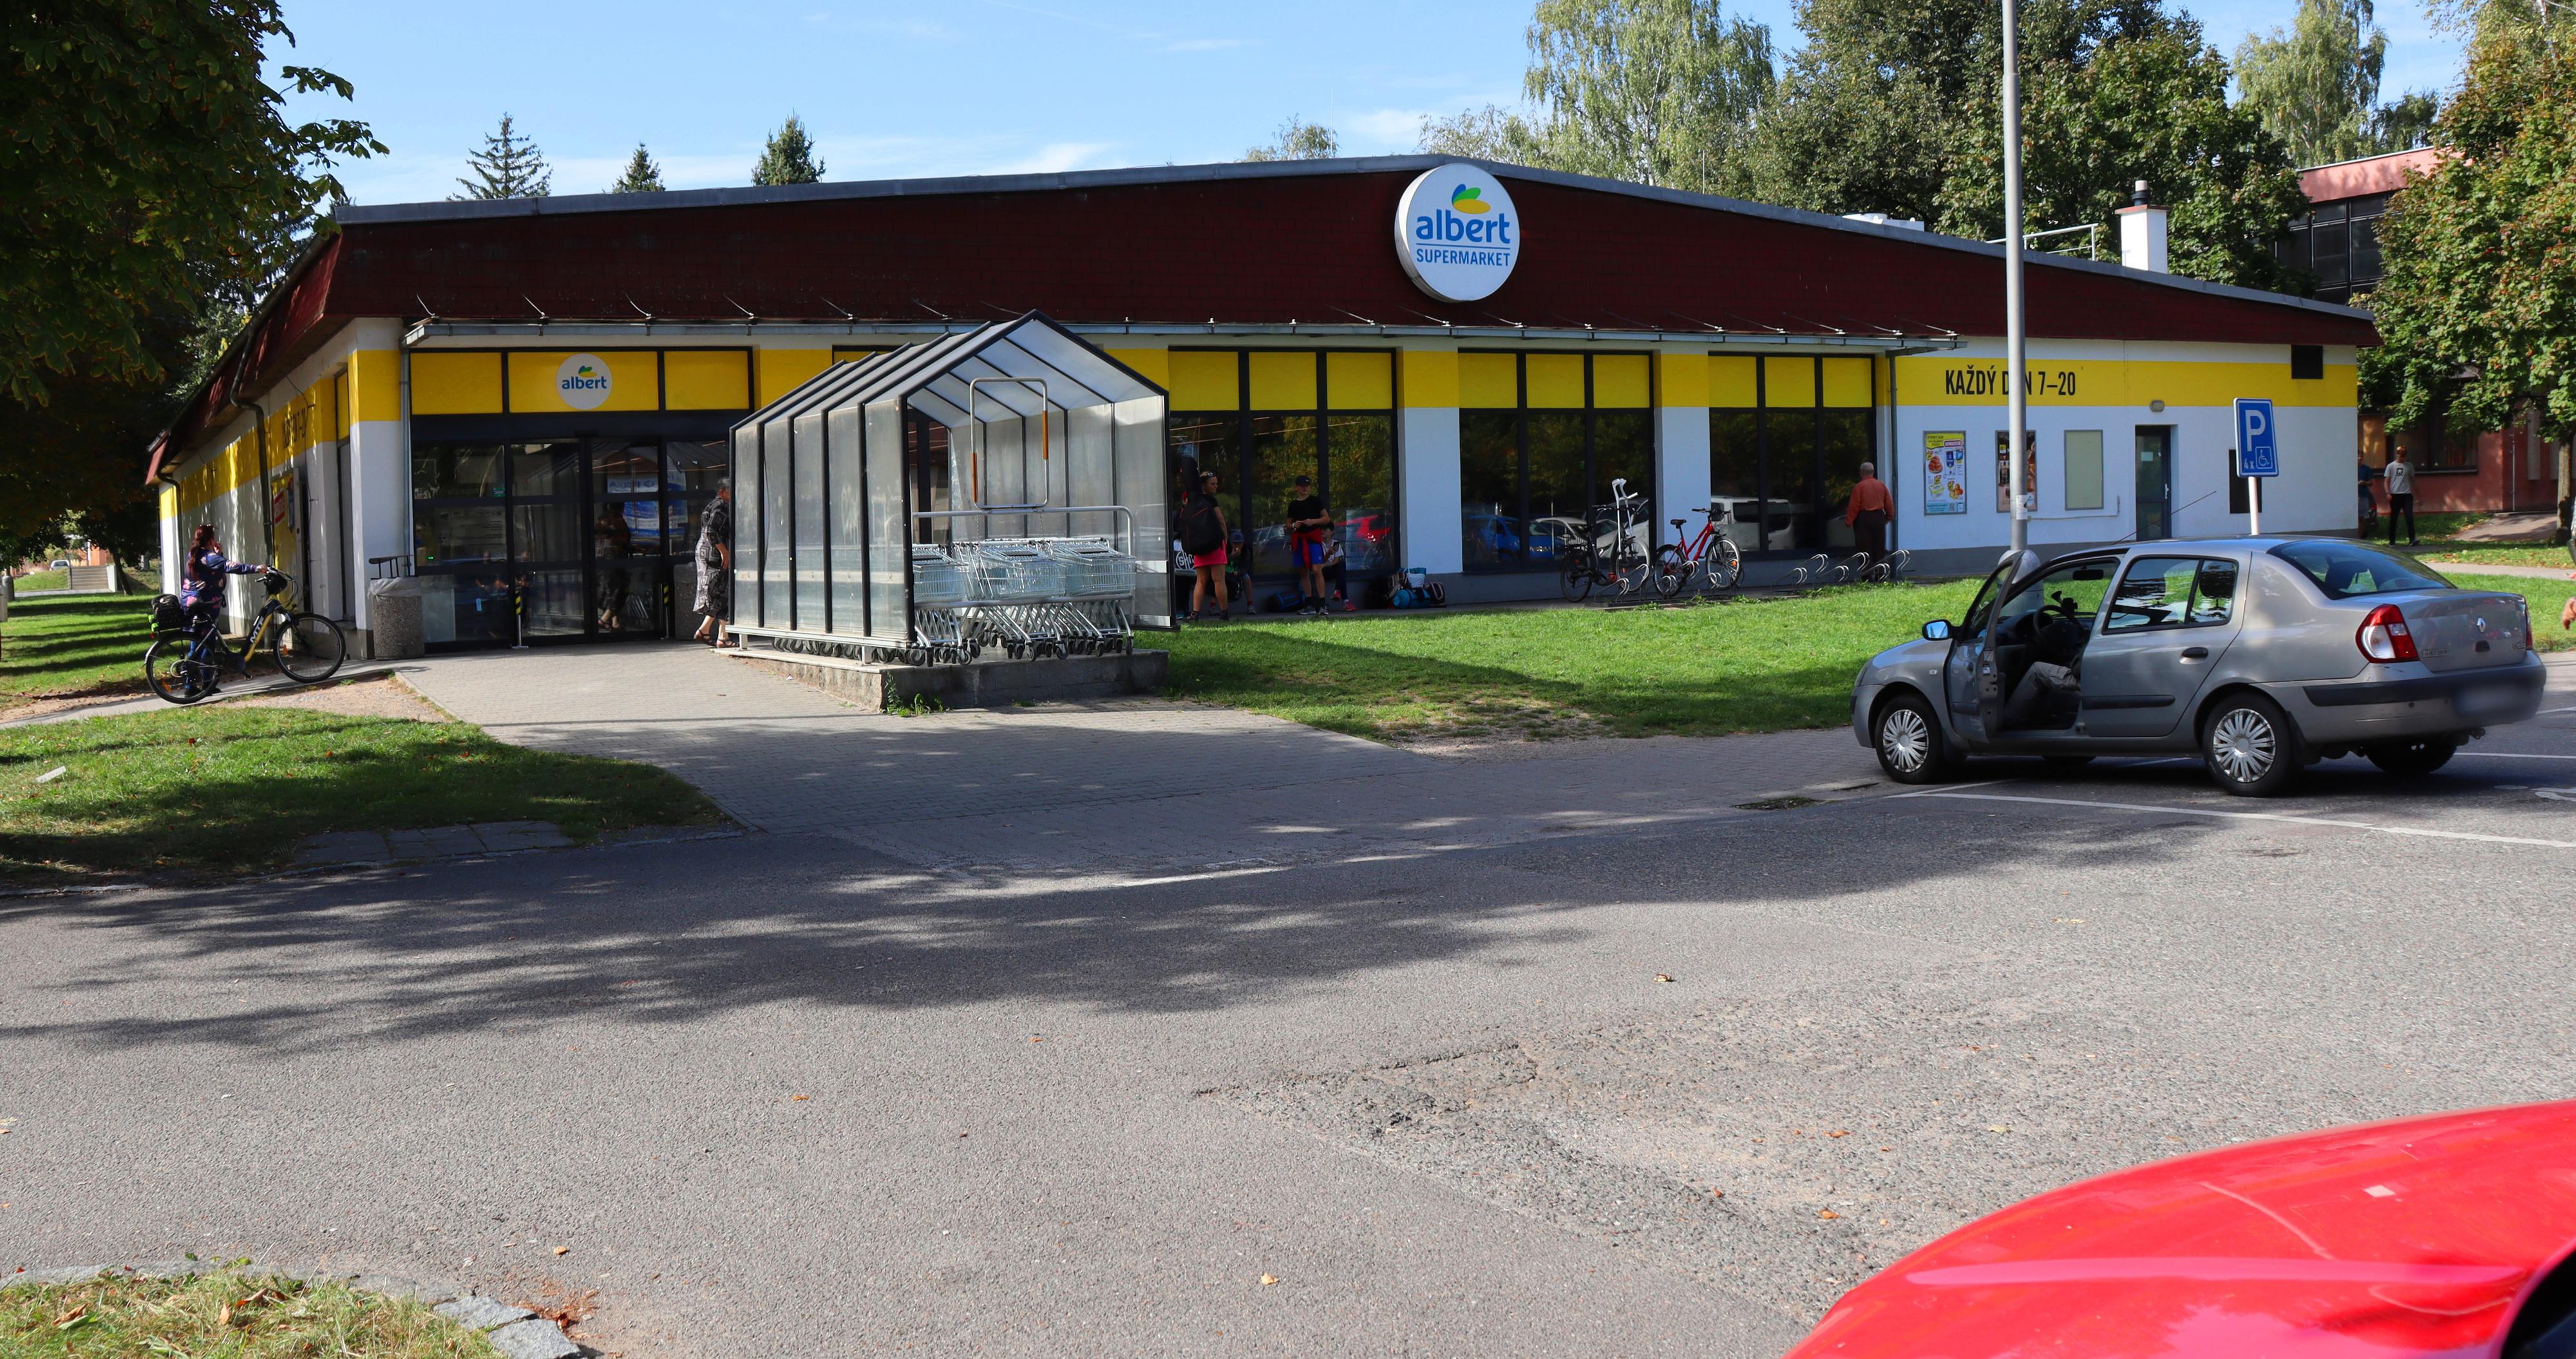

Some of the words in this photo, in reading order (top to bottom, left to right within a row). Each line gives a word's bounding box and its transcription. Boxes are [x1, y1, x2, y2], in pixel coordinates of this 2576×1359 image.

[1416, 209, 1511, 244] albert
[1416, 248, 1511, 267] SUPERMARKET
[562, 375, 607, 390] albert
[1946, 365, 1996, 395] KAŽDÝ
[2002, 371, 2032, 395] DN
[2245, 409, 2266, 451] P
